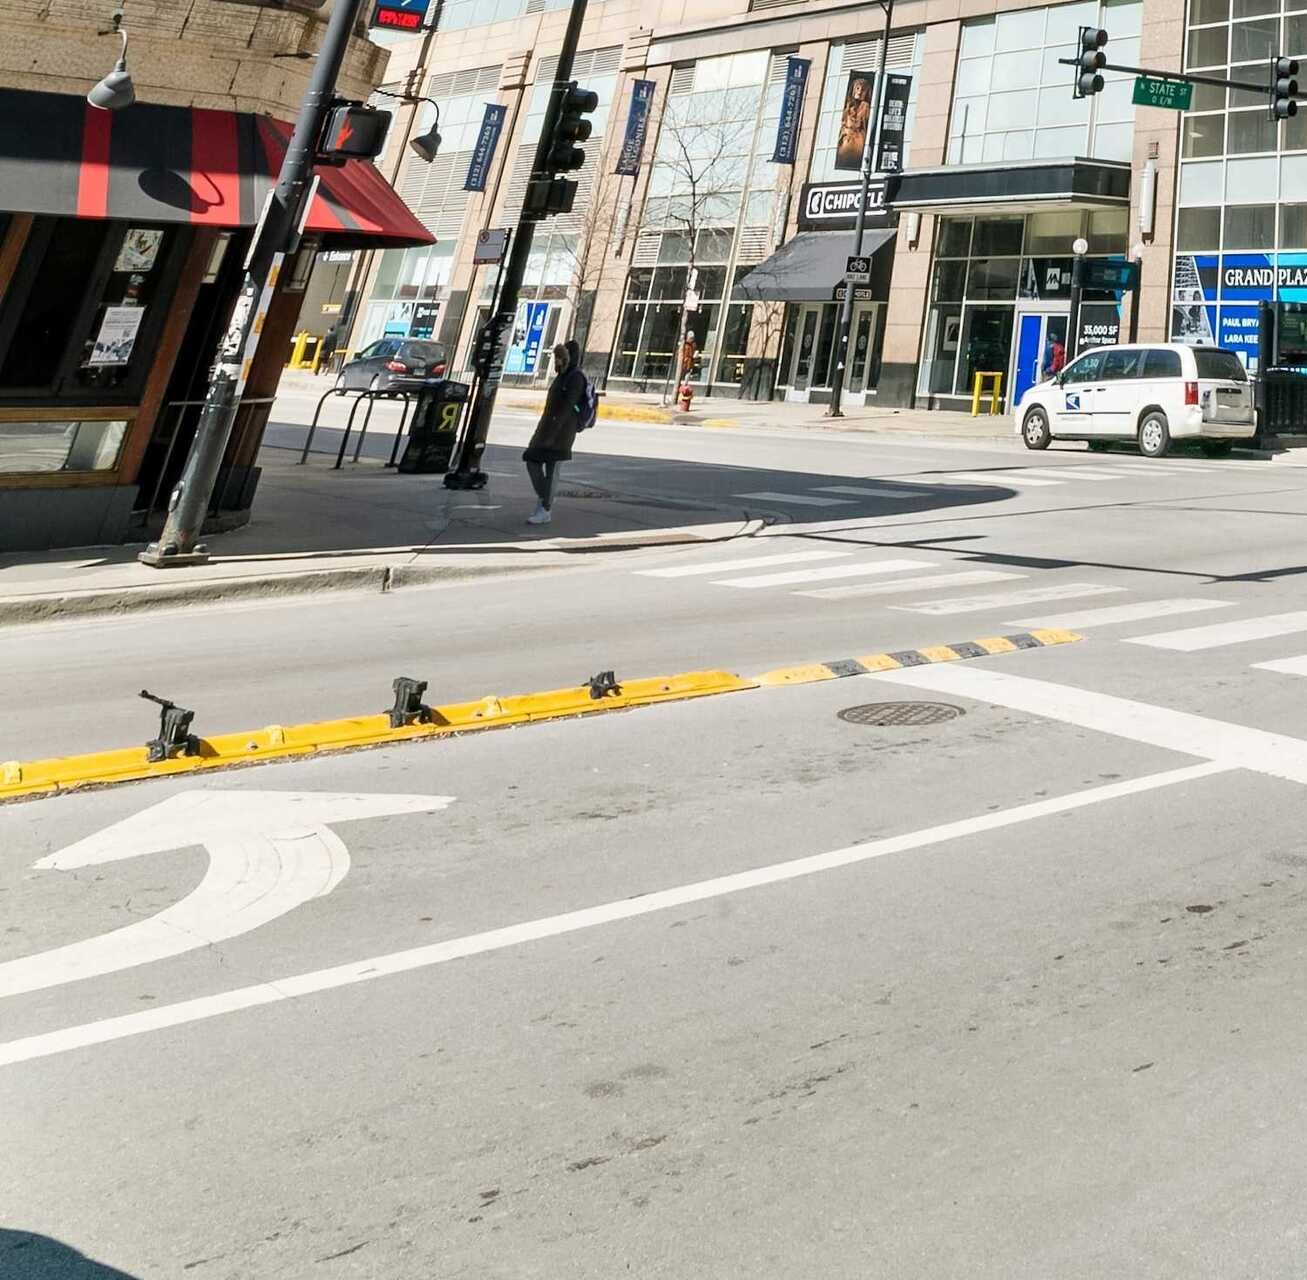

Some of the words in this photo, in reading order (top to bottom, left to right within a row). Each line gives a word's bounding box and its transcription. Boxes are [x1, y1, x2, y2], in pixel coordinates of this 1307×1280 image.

[1149, 82, 1176, 96] STATE
[825, 191, 884, 211] CHIPLE
[1224, 269, 1274, 286] GRAND
[1222, 318, 1241, 327] PAUL
[1224, 335, 1243, 344] LARA
